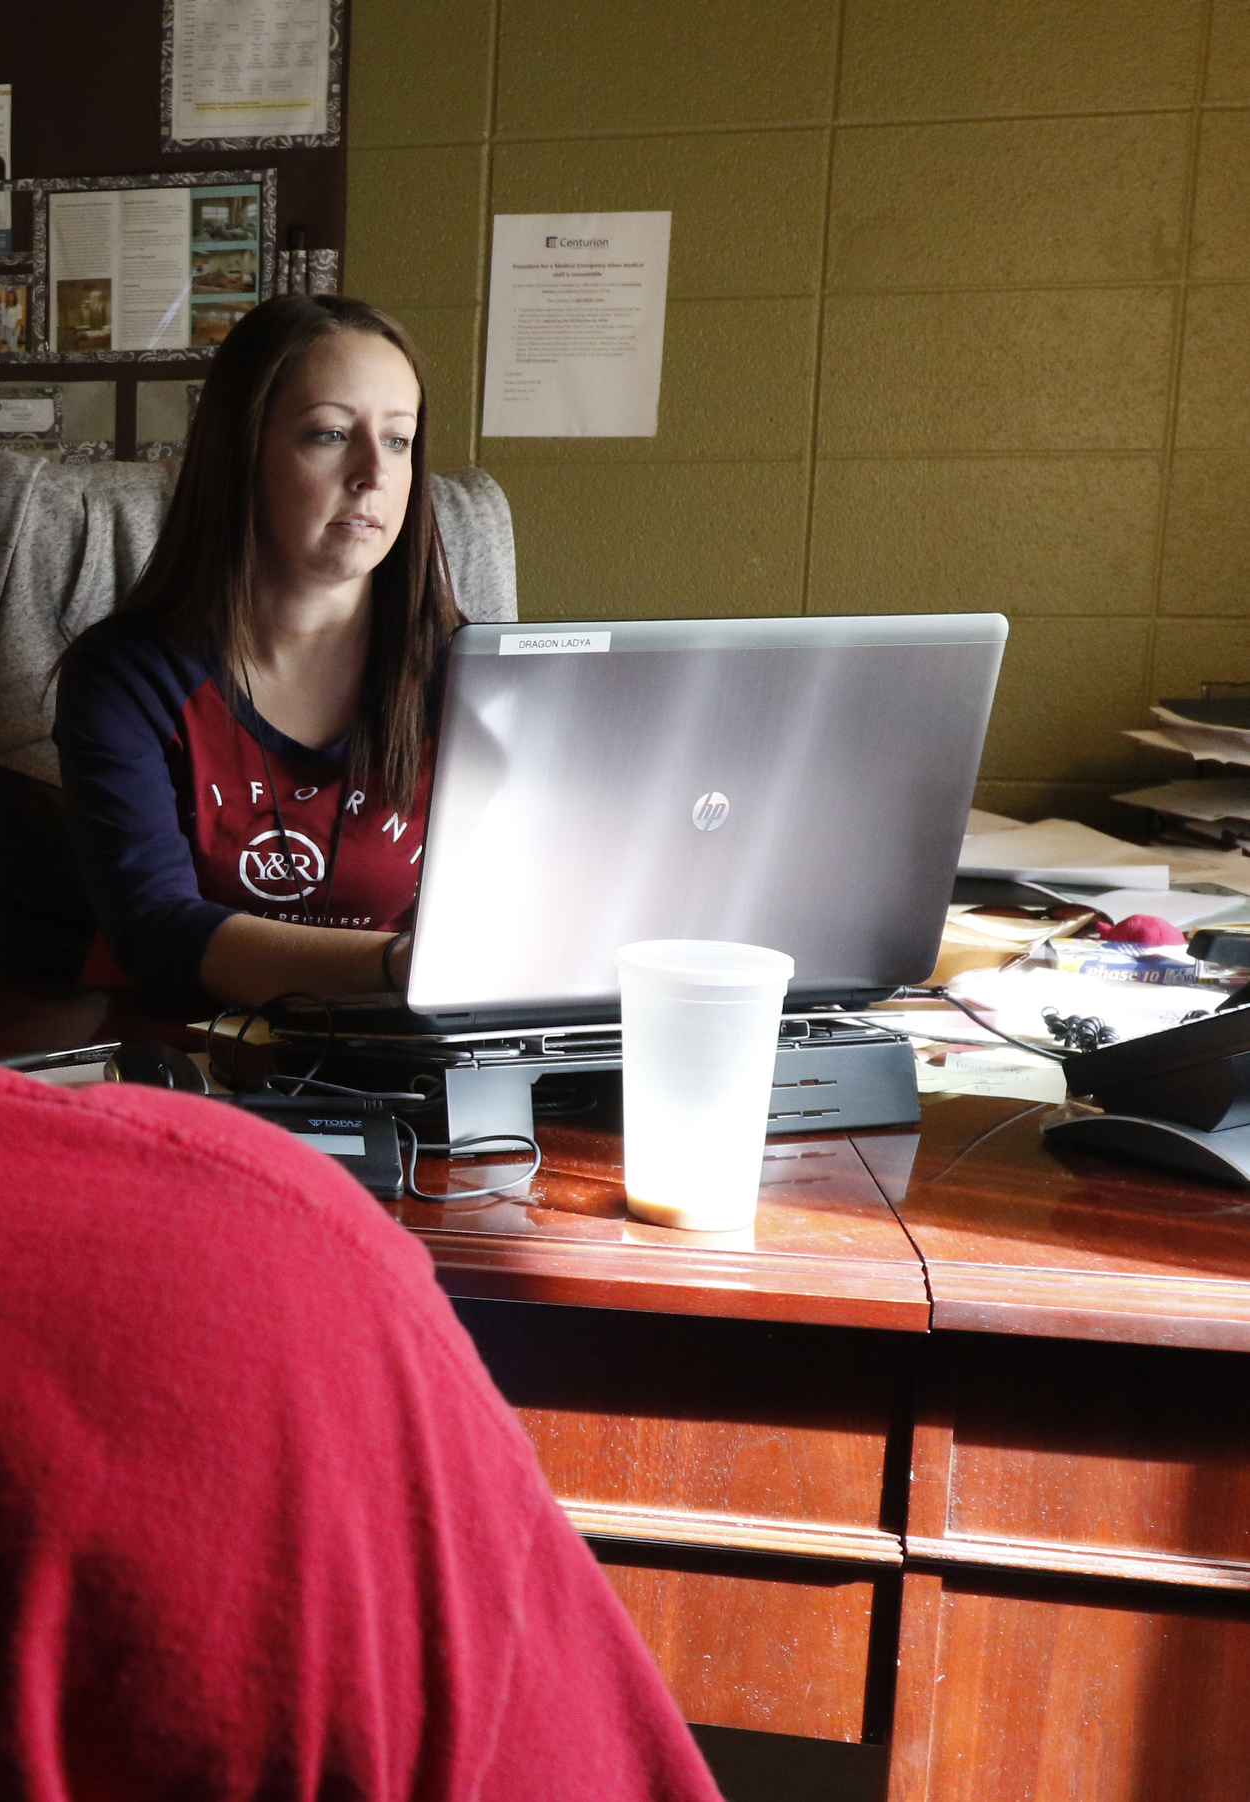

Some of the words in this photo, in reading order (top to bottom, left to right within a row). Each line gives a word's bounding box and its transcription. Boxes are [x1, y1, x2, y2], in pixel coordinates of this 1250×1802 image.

[559, 237, 610, 248] Centurion
[518, 639, 558, 649] DRAGON
[561, 638, 591, 648] LADYA
[695, 791, 728, 831] hp
[250, 851, 316, 881] Y&R
[1086, 964, 1140, 982] Phase
[1142, 970, 1161, 983] 10
